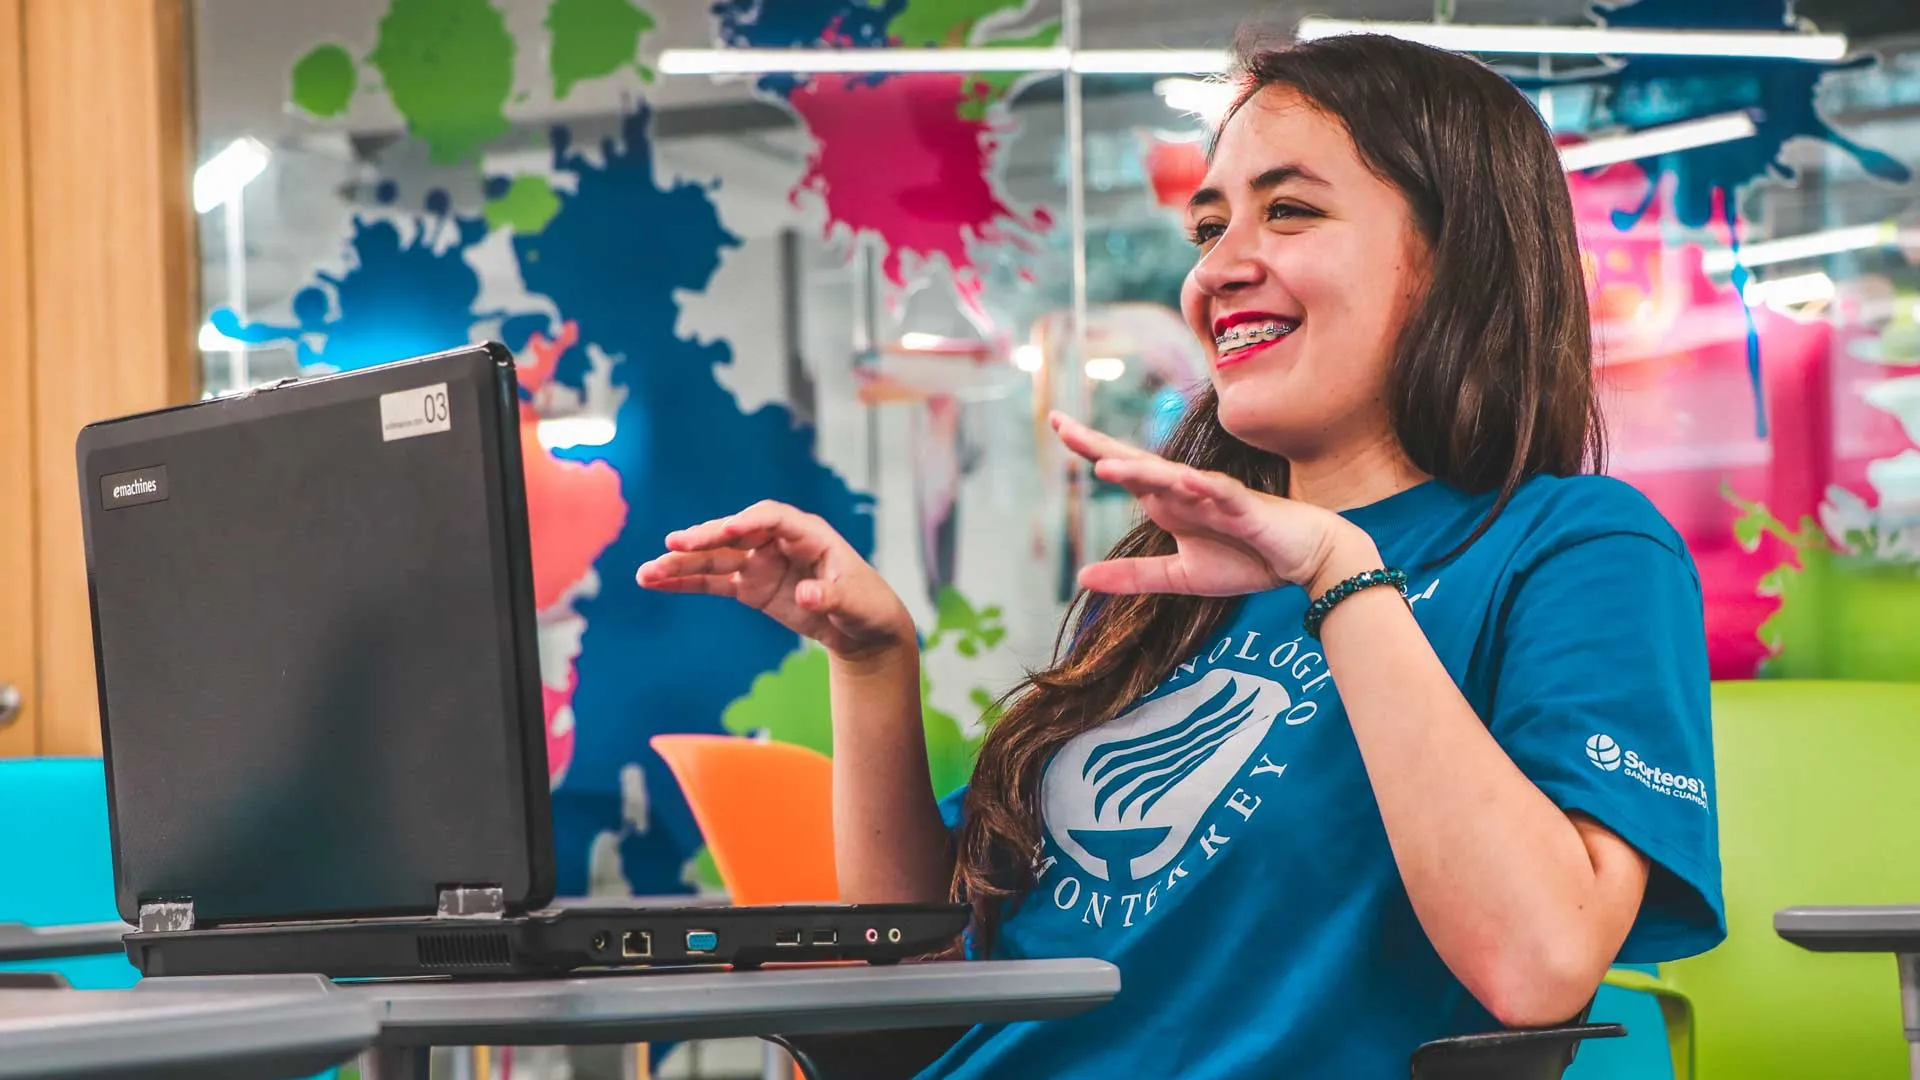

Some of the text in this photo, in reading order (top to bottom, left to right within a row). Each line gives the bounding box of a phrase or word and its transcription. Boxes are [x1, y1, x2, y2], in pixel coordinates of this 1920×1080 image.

[424, 392, 447, 423] 03
[113, 478, 157, 498] emachines
[1624, 750, 1698, 793] Sorteos
